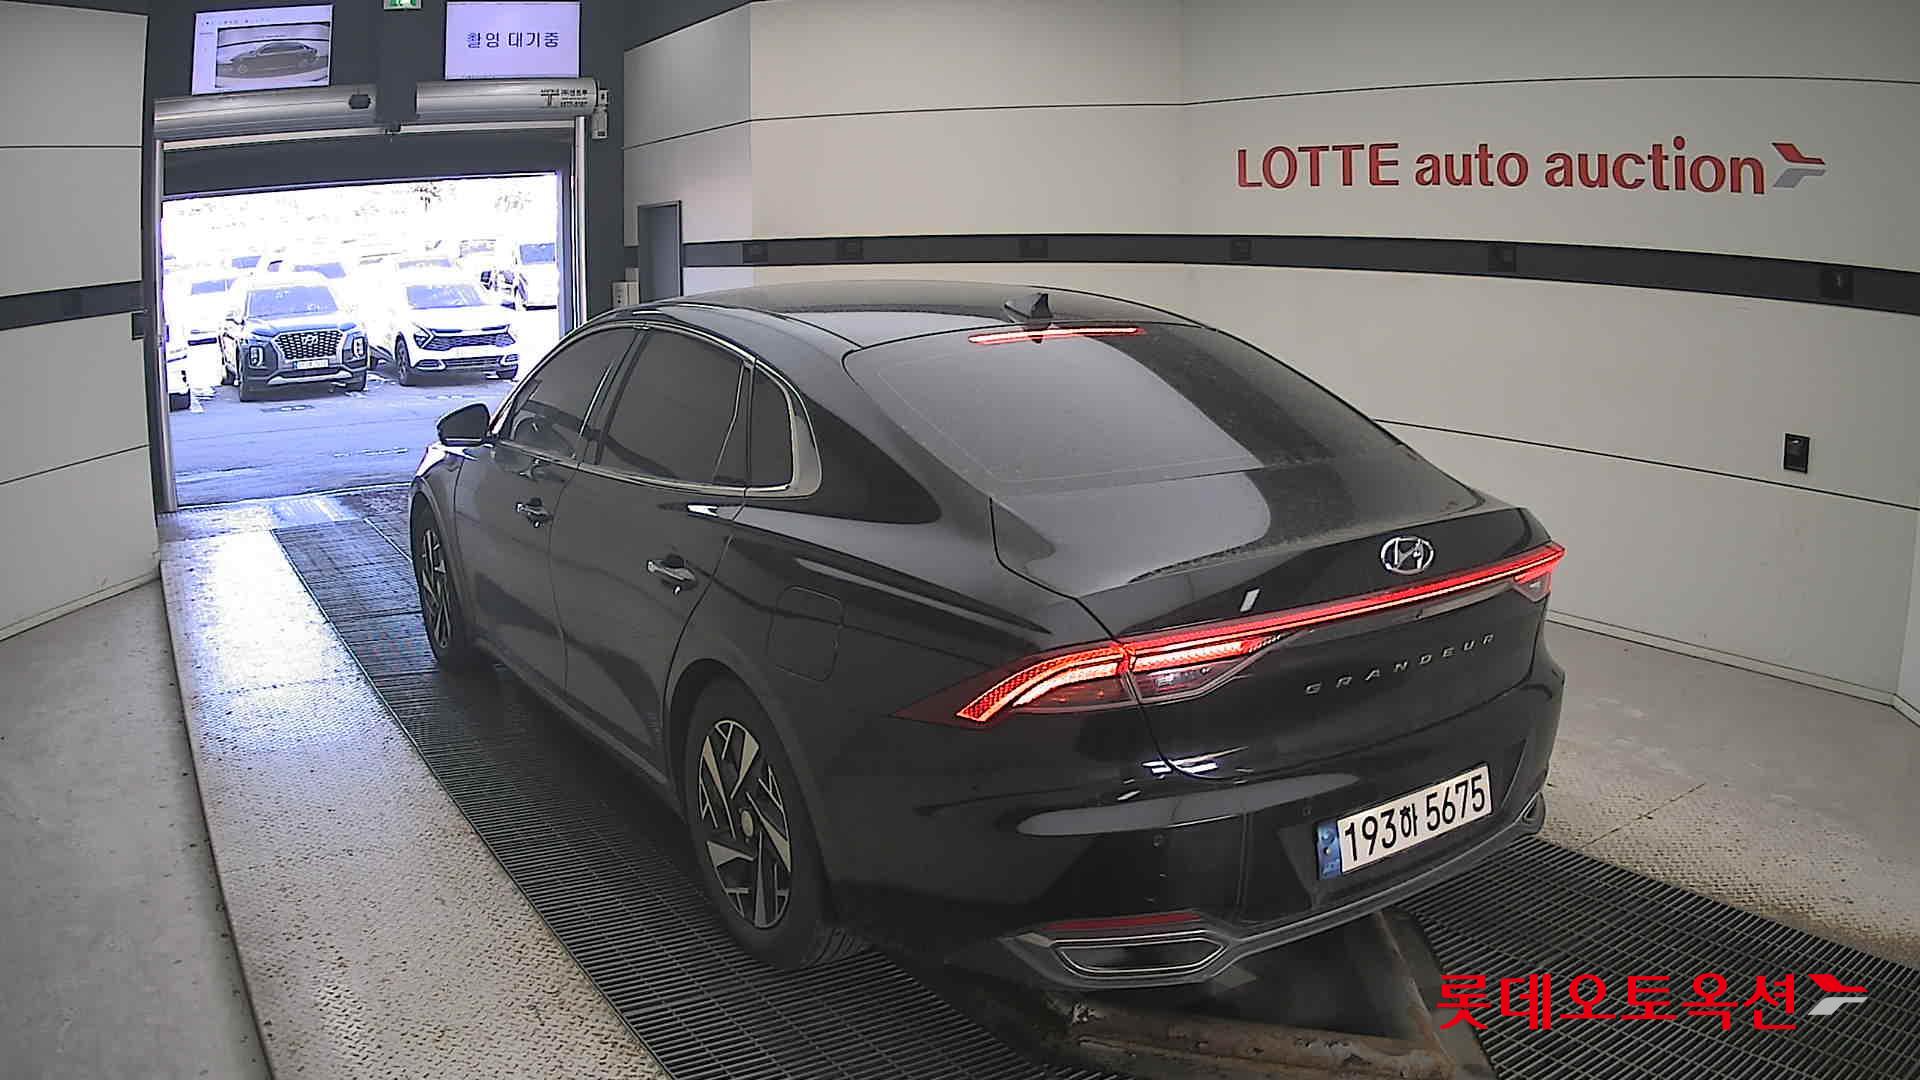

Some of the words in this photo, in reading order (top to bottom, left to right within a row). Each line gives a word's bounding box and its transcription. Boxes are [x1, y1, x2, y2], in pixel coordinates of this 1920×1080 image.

[508, 32, 560, 48] 대기중
[1237, 142, 1400, 189] LOTTE
[1415, 143, 1529, 188] auto
[1545, 136, 1766, 195] auction
[1305, 633, 1495, 695] GRANDEUR
[1344, 803, 1418, 862] 193하
[1426, 775, 1486, 832] 5675
